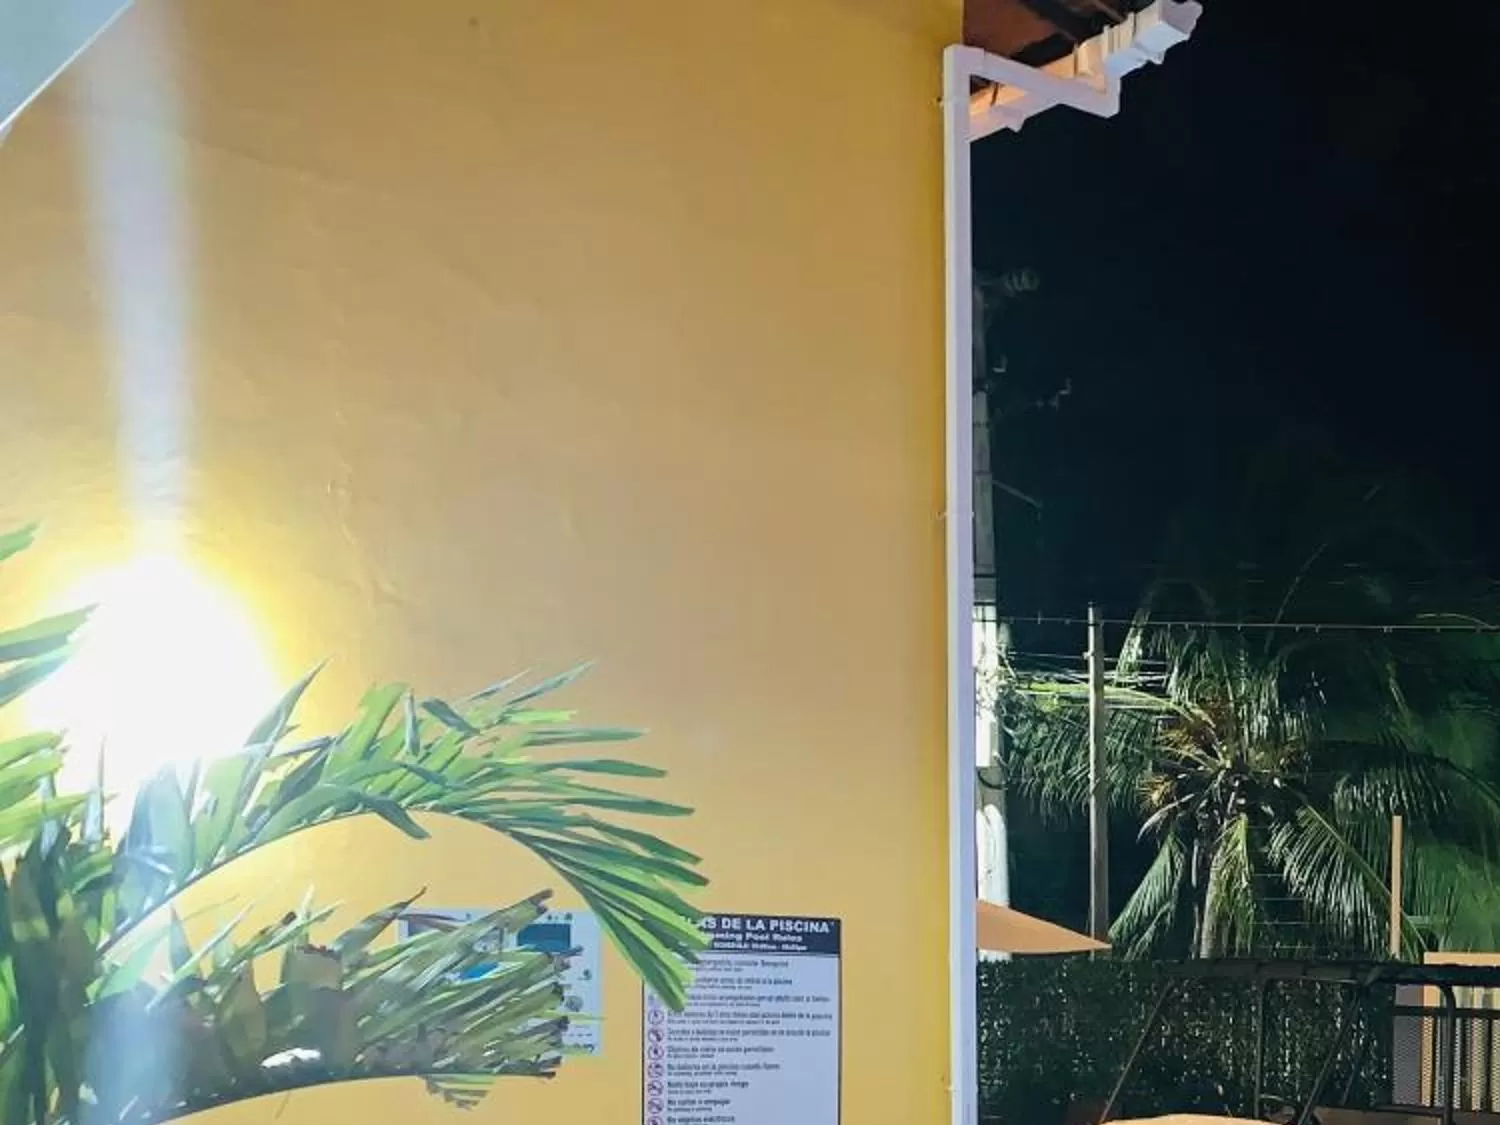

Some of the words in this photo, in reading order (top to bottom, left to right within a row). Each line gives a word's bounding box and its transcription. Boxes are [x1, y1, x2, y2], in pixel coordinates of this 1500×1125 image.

[721, 917, 741, 930] DE
[746, 918, 766, 931] LA
[769, 919, 830, 933] PISCINA
